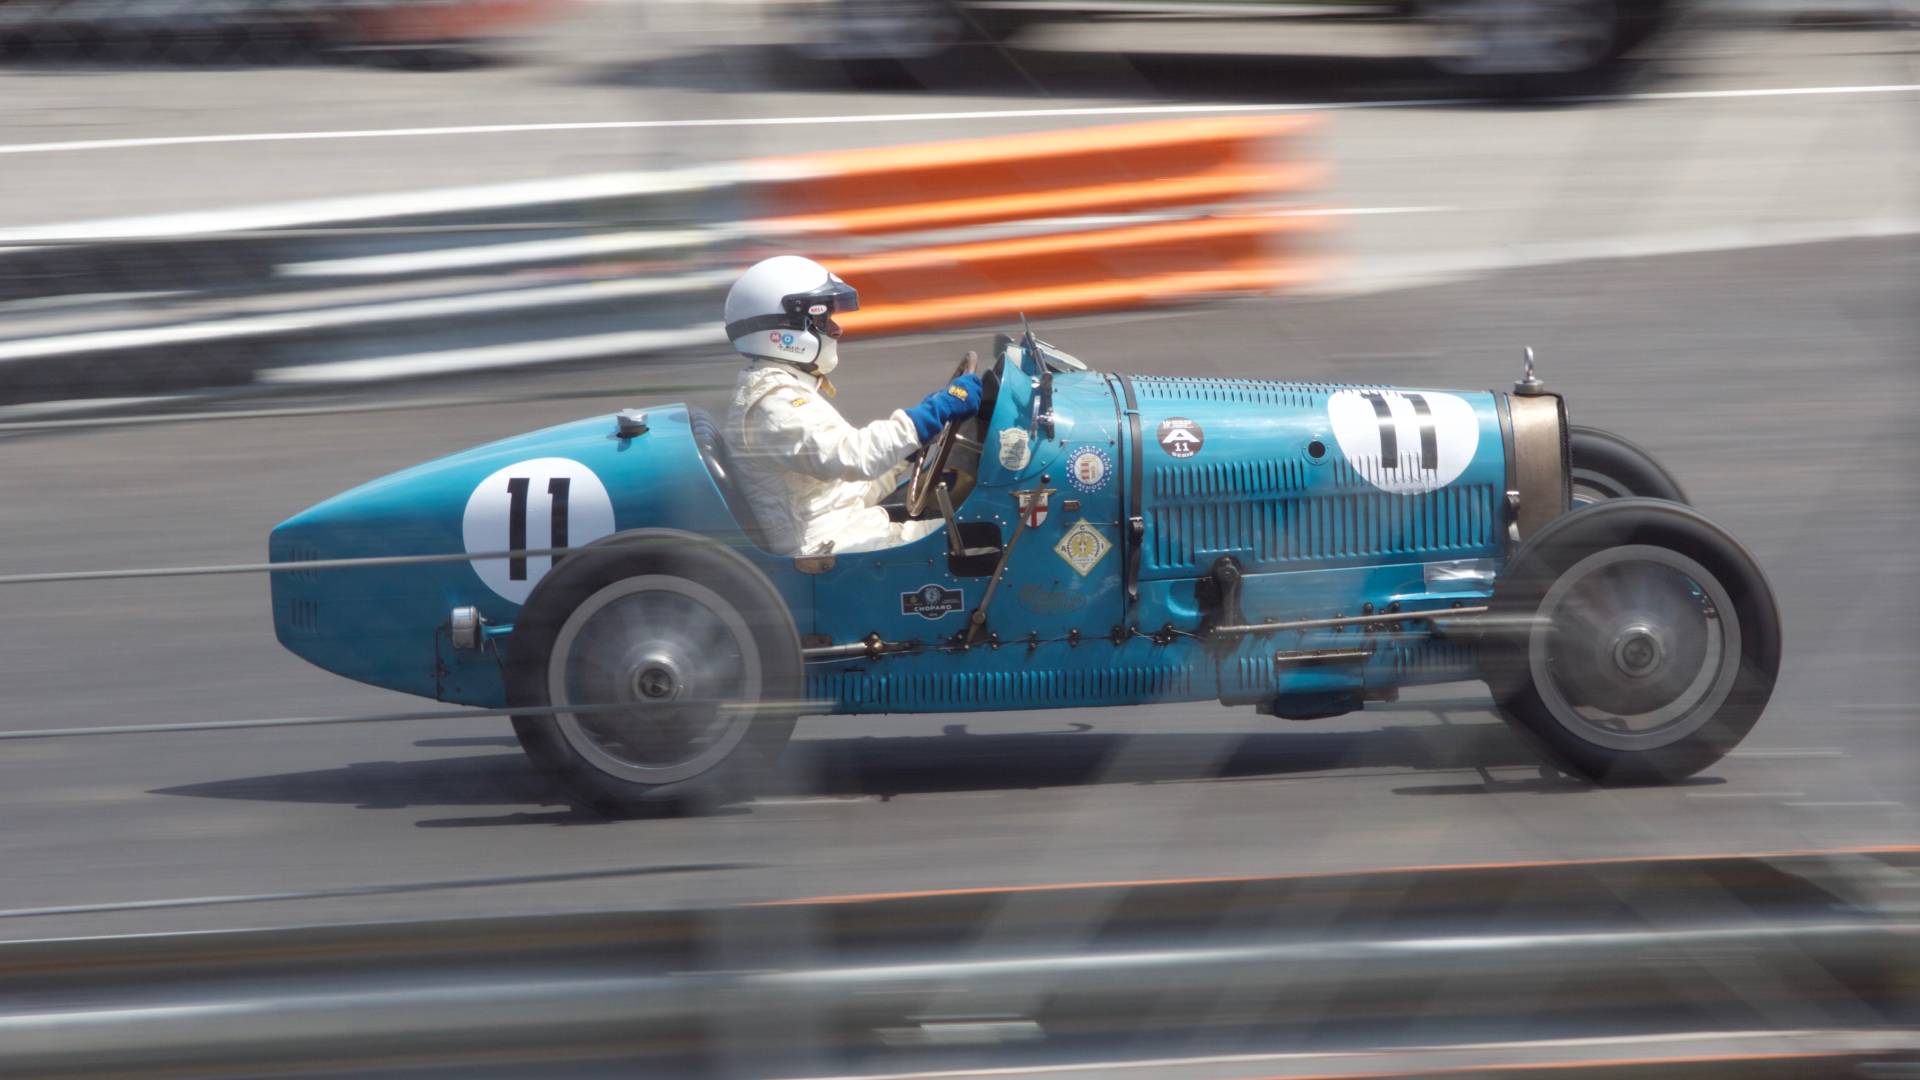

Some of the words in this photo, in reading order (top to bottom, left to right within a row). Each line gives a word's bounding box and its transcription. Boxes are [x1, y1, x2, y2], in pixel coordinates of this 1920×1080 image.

[1162, 429, 1201, 444] A
[1360, 392, 1439, 470] 11
[1174, 442, 1190, 452] 11
[507, 477, 571, 581] 11
[913, 604, 952, 612] CHOPARD
